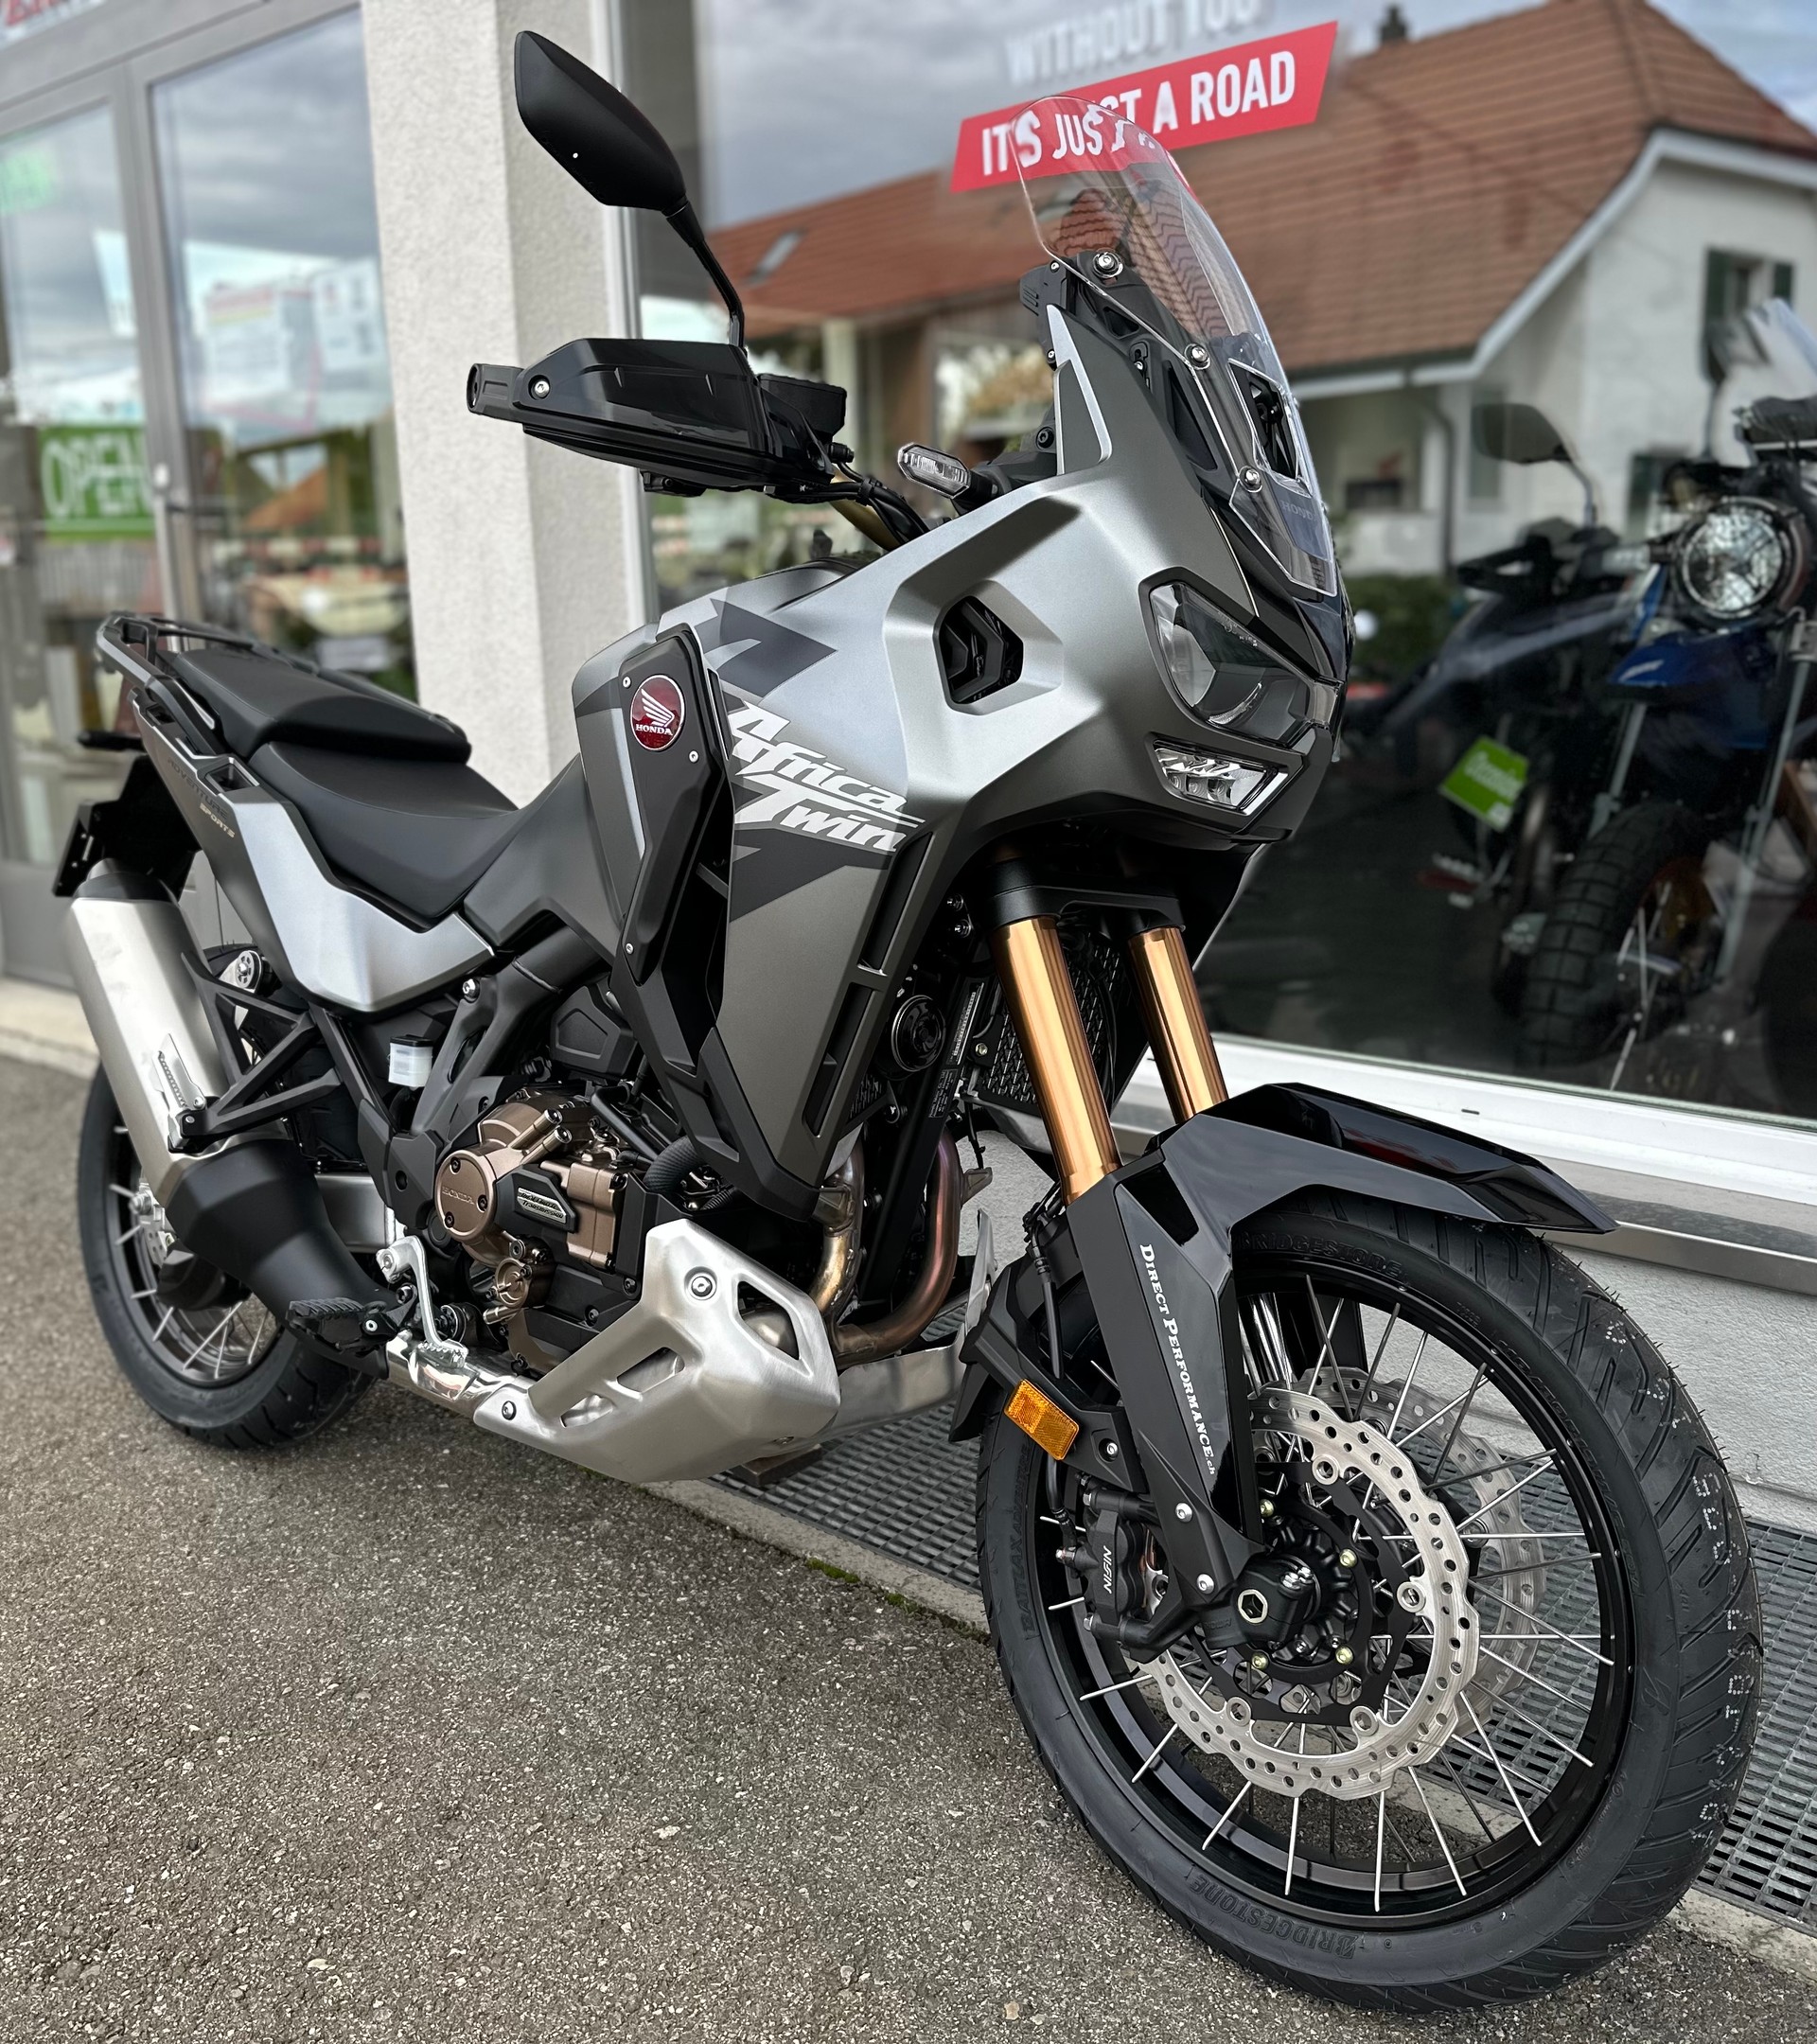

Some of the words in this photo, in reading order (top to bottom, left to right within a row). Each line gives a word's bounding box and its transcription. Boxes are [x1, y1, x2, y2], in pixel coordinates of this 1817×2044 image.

[1152, 80, 1178, 134] A
[1190, 50, 1297, 125] ROAD
[635, 723, 674, 737] HONDA
[728, 699, 908, 814] Africa
[168, 759, 228, 820] ADVENTURE
[200, 802, 236, 838] SPORTS
[734, 772, 920, 852] Twin
[1190, 1874, 1359, 1959] BRIDGESTONE
